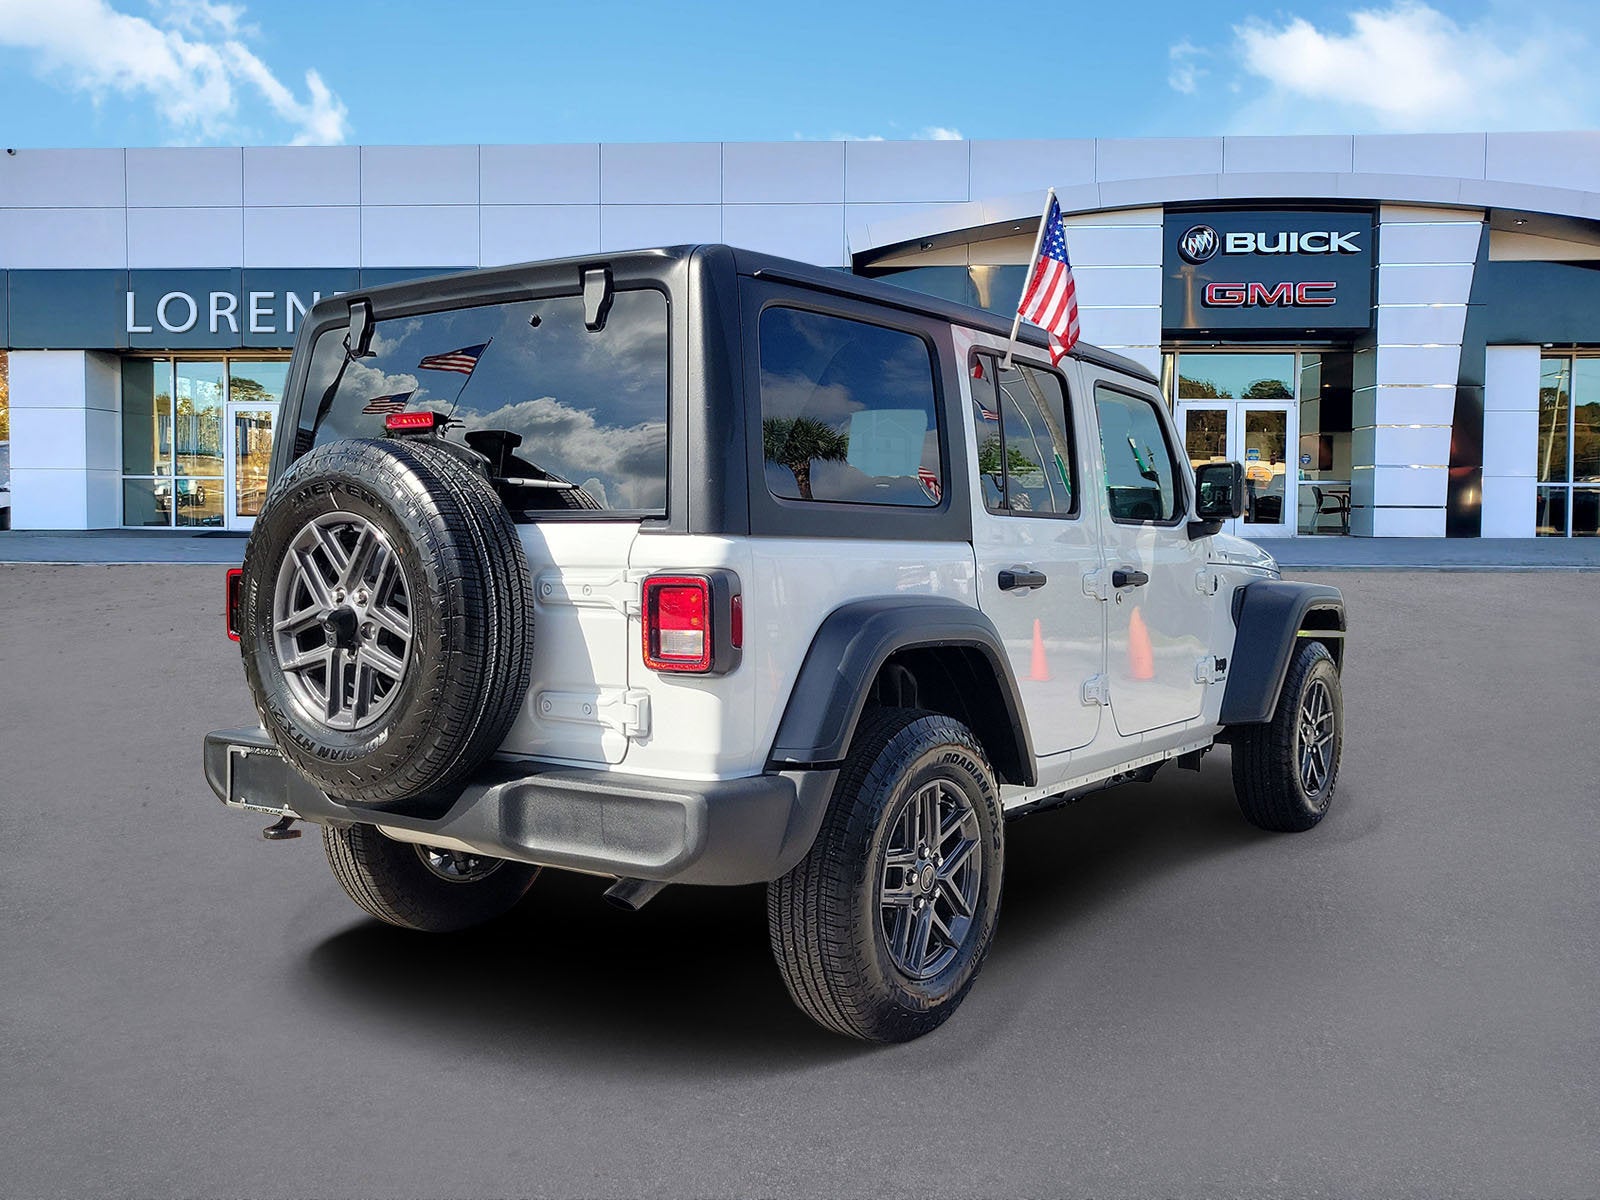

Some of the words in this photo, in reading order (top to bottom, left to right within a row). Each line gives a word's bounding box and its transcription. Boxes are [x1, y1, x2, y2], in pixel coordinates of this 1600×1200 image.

[1225, 231, 1362, 253] BUICK
[1205, 281, 1337, 305] GMC
[126, 291, 350, 333] LOREN
[296, 480, 376, 508] NEXEN
[942, 753, 990, 794] ROADIAN
[985, 796, 1001, 850] HTX2
